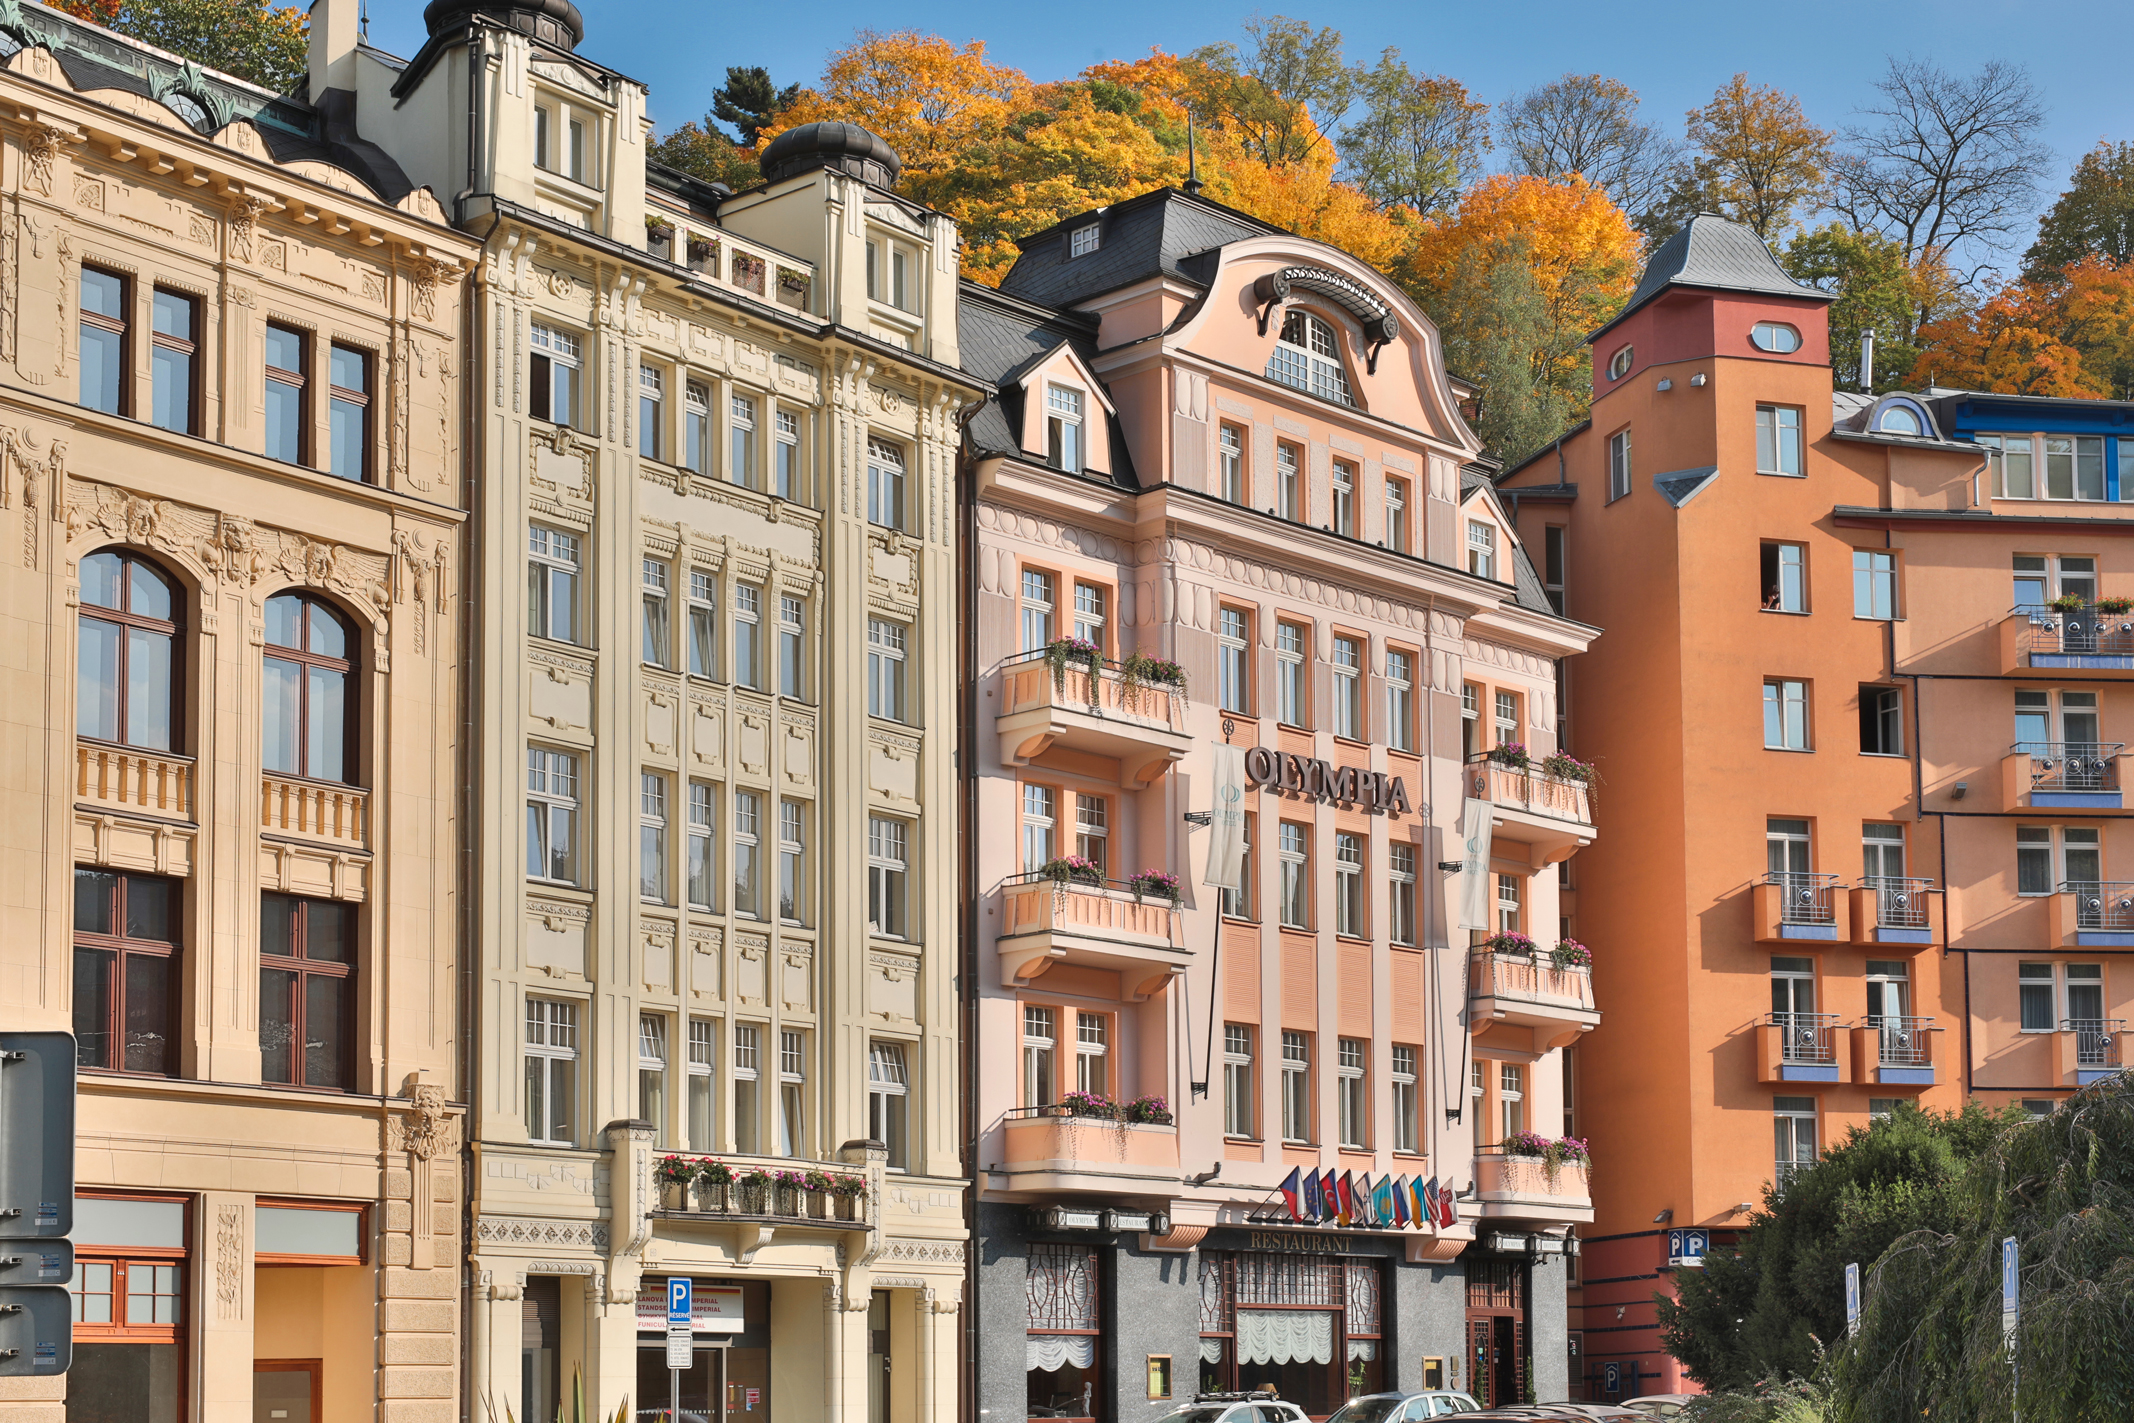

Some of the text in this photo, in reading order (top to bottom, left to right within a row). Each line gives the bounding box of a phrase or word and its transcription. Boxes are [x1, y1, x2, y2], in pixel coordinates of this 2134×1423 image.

[1246, 747, 1412, 813] OLYMPIA
[1119, 1217, 1147, 1227] ESTAURAN
[1251, 1231, 1352, 1252] RESTAURANT
[1672, 1238, 1681, 1256] P
[1689, 1237, 1704, 1255] P
[2005, 1244, 2012, 1284] P
[672, 1283, 687, 1310] P
[1848, 1272, 1854, 1305] P
[637, 1295, 664, 1303] LANOVÁ
[1608, 1370, 1616, 1388] P
